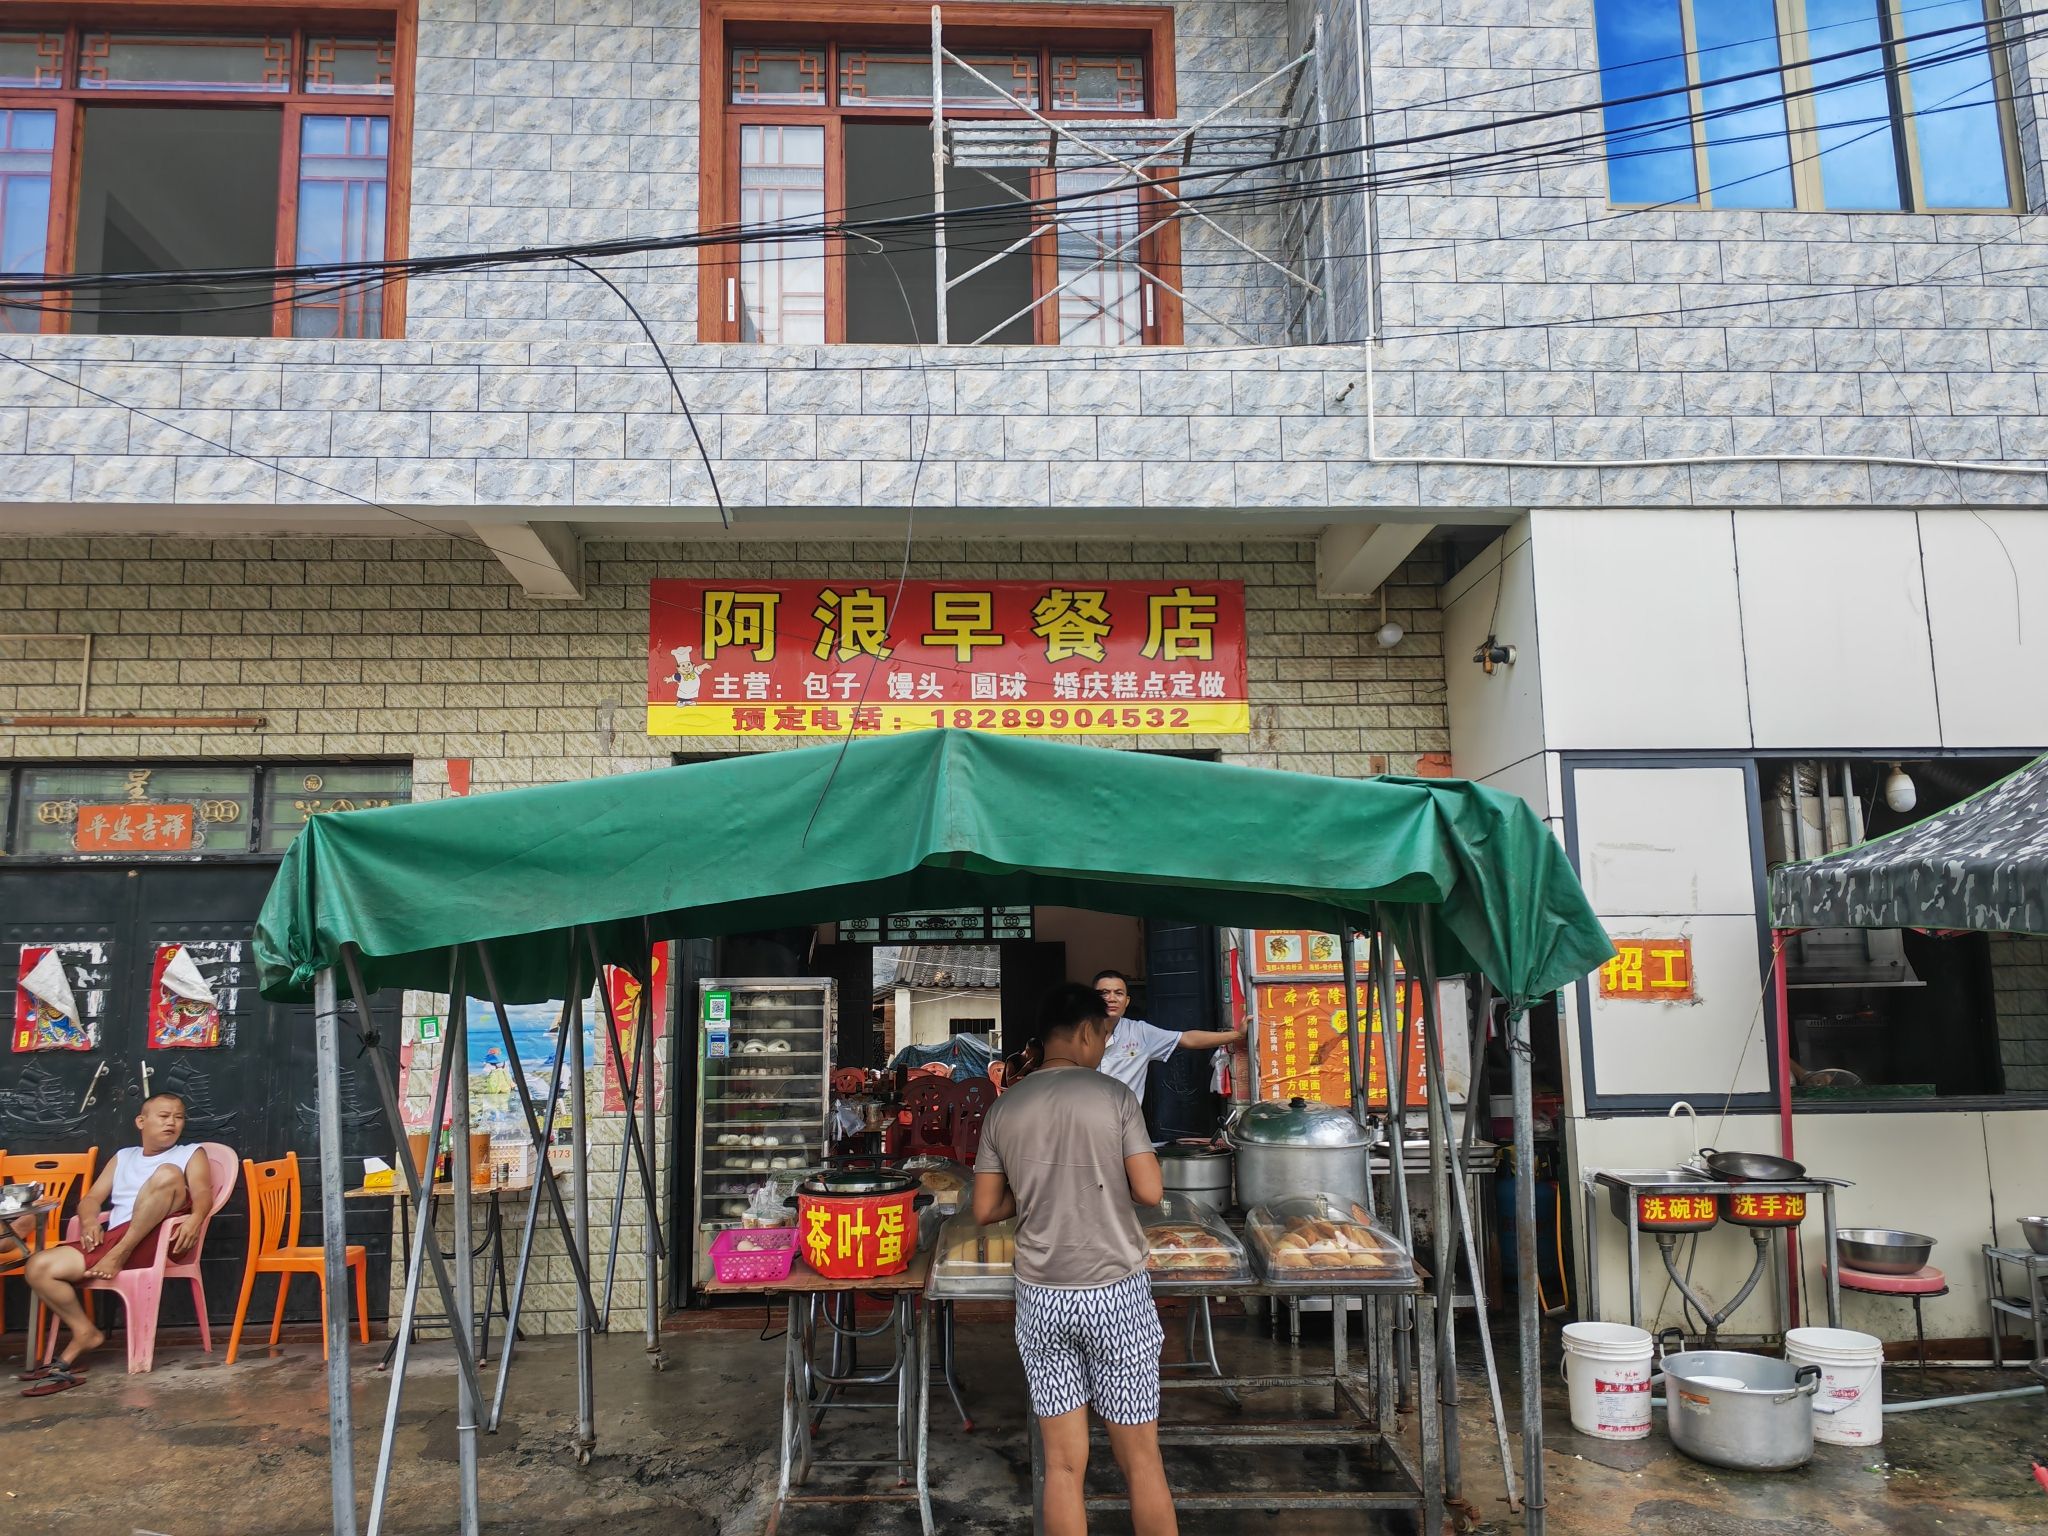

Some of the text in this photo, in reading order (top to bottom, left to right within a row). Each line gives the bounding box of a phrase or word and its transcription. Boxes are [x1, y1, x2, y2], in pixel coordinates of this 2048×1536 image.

[702, 587, 1218, 663] 阿浪早餐店
[803, 672, 861, 700] 包子
[887, 672, 944, 700] 馒头
[971, 671, 1028, 700] 圆球
[1053, 671, 1226, 699] 婚庆糕点定做
[930, 707, 1190, 729] 18289904532
[85, 813, 188, 843] 平安吉祥
[1603, 946, 1690, 992] 招工
[1644, 1197, 1715, 1220] 洗碗池
[1735, 1194, 1804, 1217] 洗手池
[806, 1204, 905, 1268] 茶叶蛋
